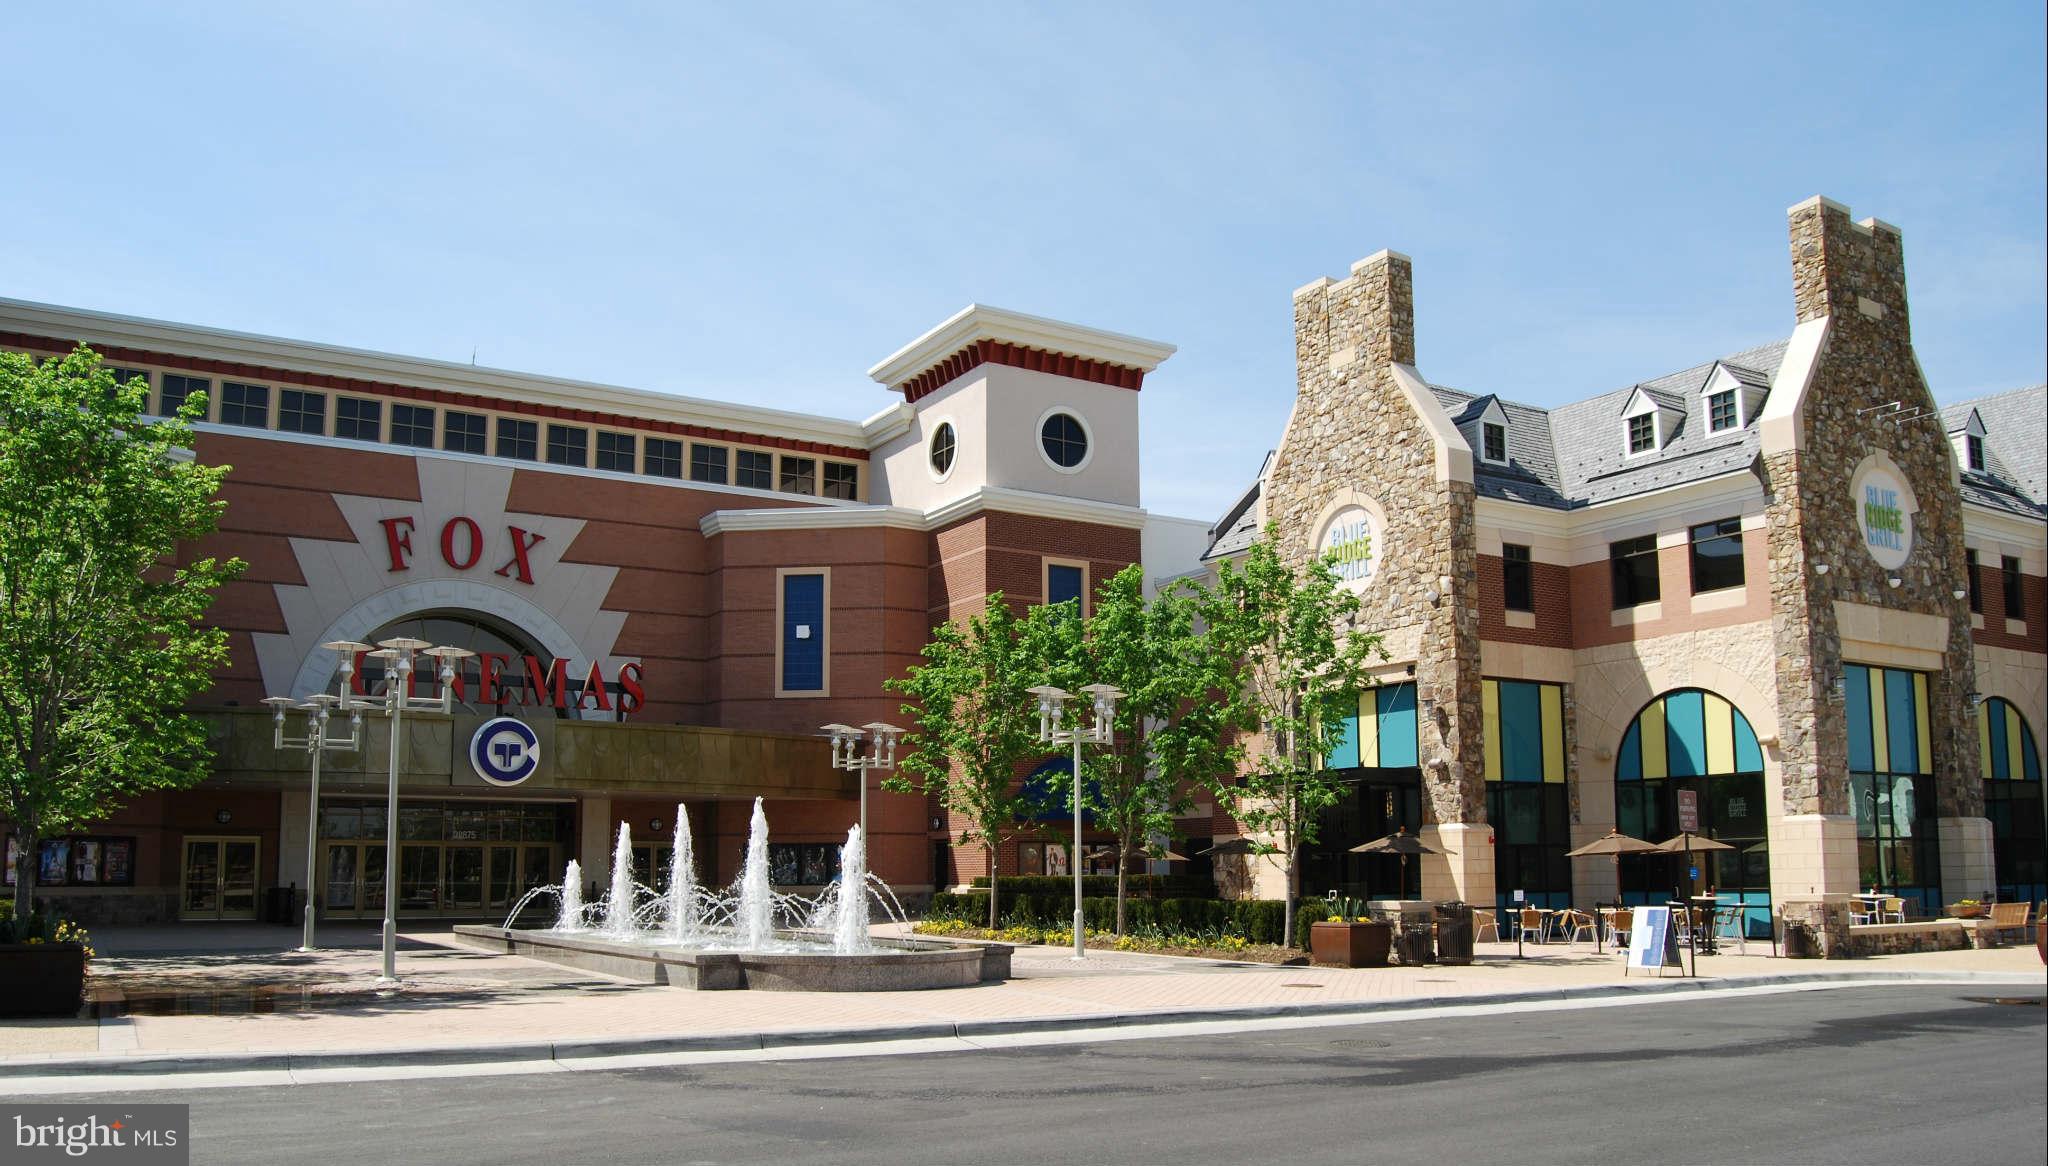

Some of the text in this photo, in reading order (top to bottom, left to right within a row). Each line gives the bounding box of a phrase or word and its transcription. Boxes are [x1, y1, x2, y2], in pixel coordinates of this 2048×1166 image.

[1865, 485, 1897, 509] BLUE
[1864, 503, 1904, 534] RIDGE
[1331, 520, 1368, 547] BLUE
[1867, 526, 1903, 551] GRILL
[378, 515, 546, 586] FOX
[1327, 536, 1373, 564] RIDGE
